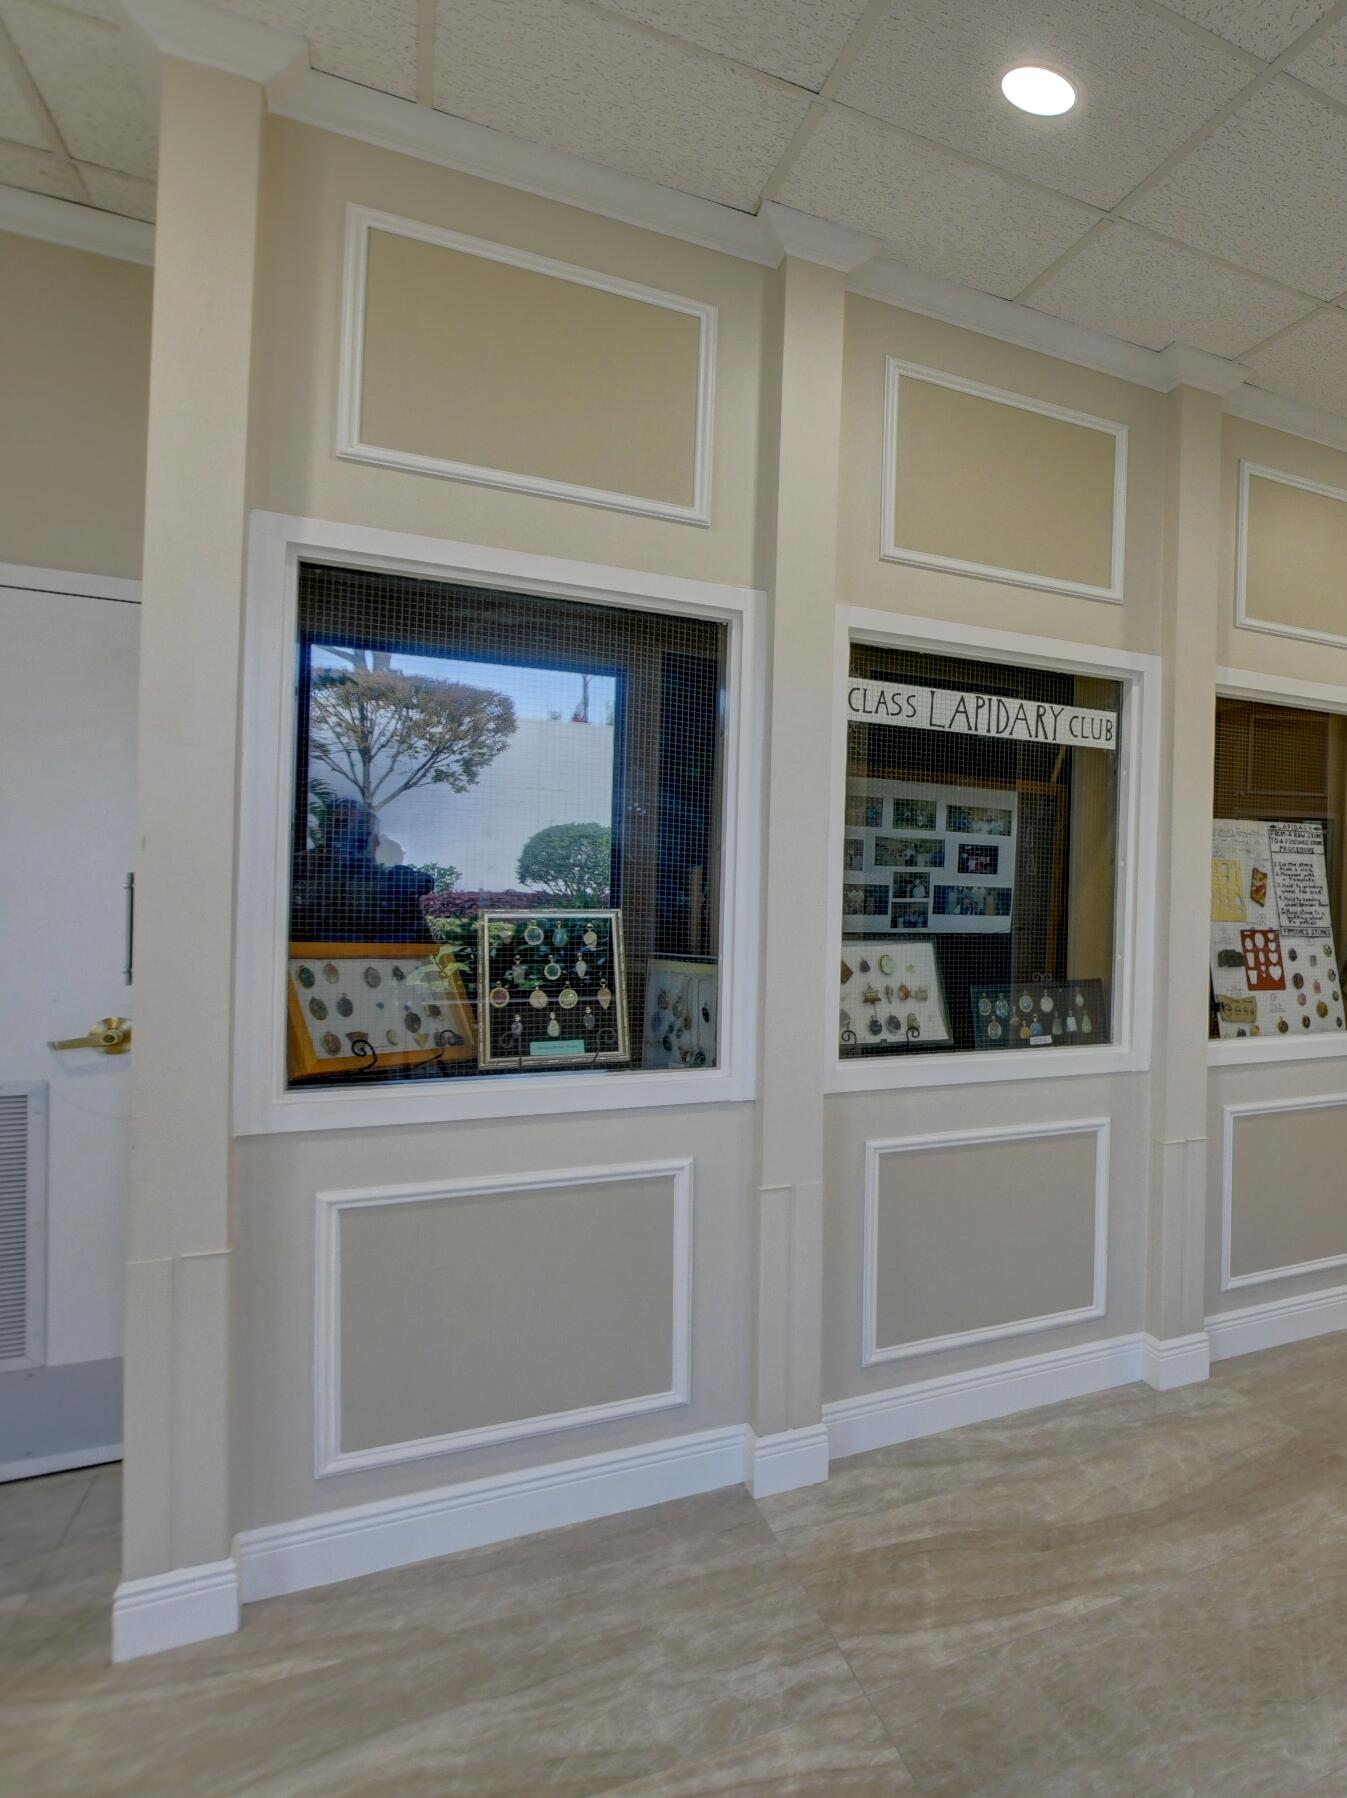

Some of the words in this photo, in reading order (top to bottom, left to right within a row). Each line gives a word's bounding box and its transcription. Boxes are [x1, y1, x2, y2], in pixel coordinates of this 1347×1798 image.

[848, 686, 917, 718] CLASS
[929, 690, 1065, 742] LAPIDARY
[1069, 715, 1114, 741] CLUB
